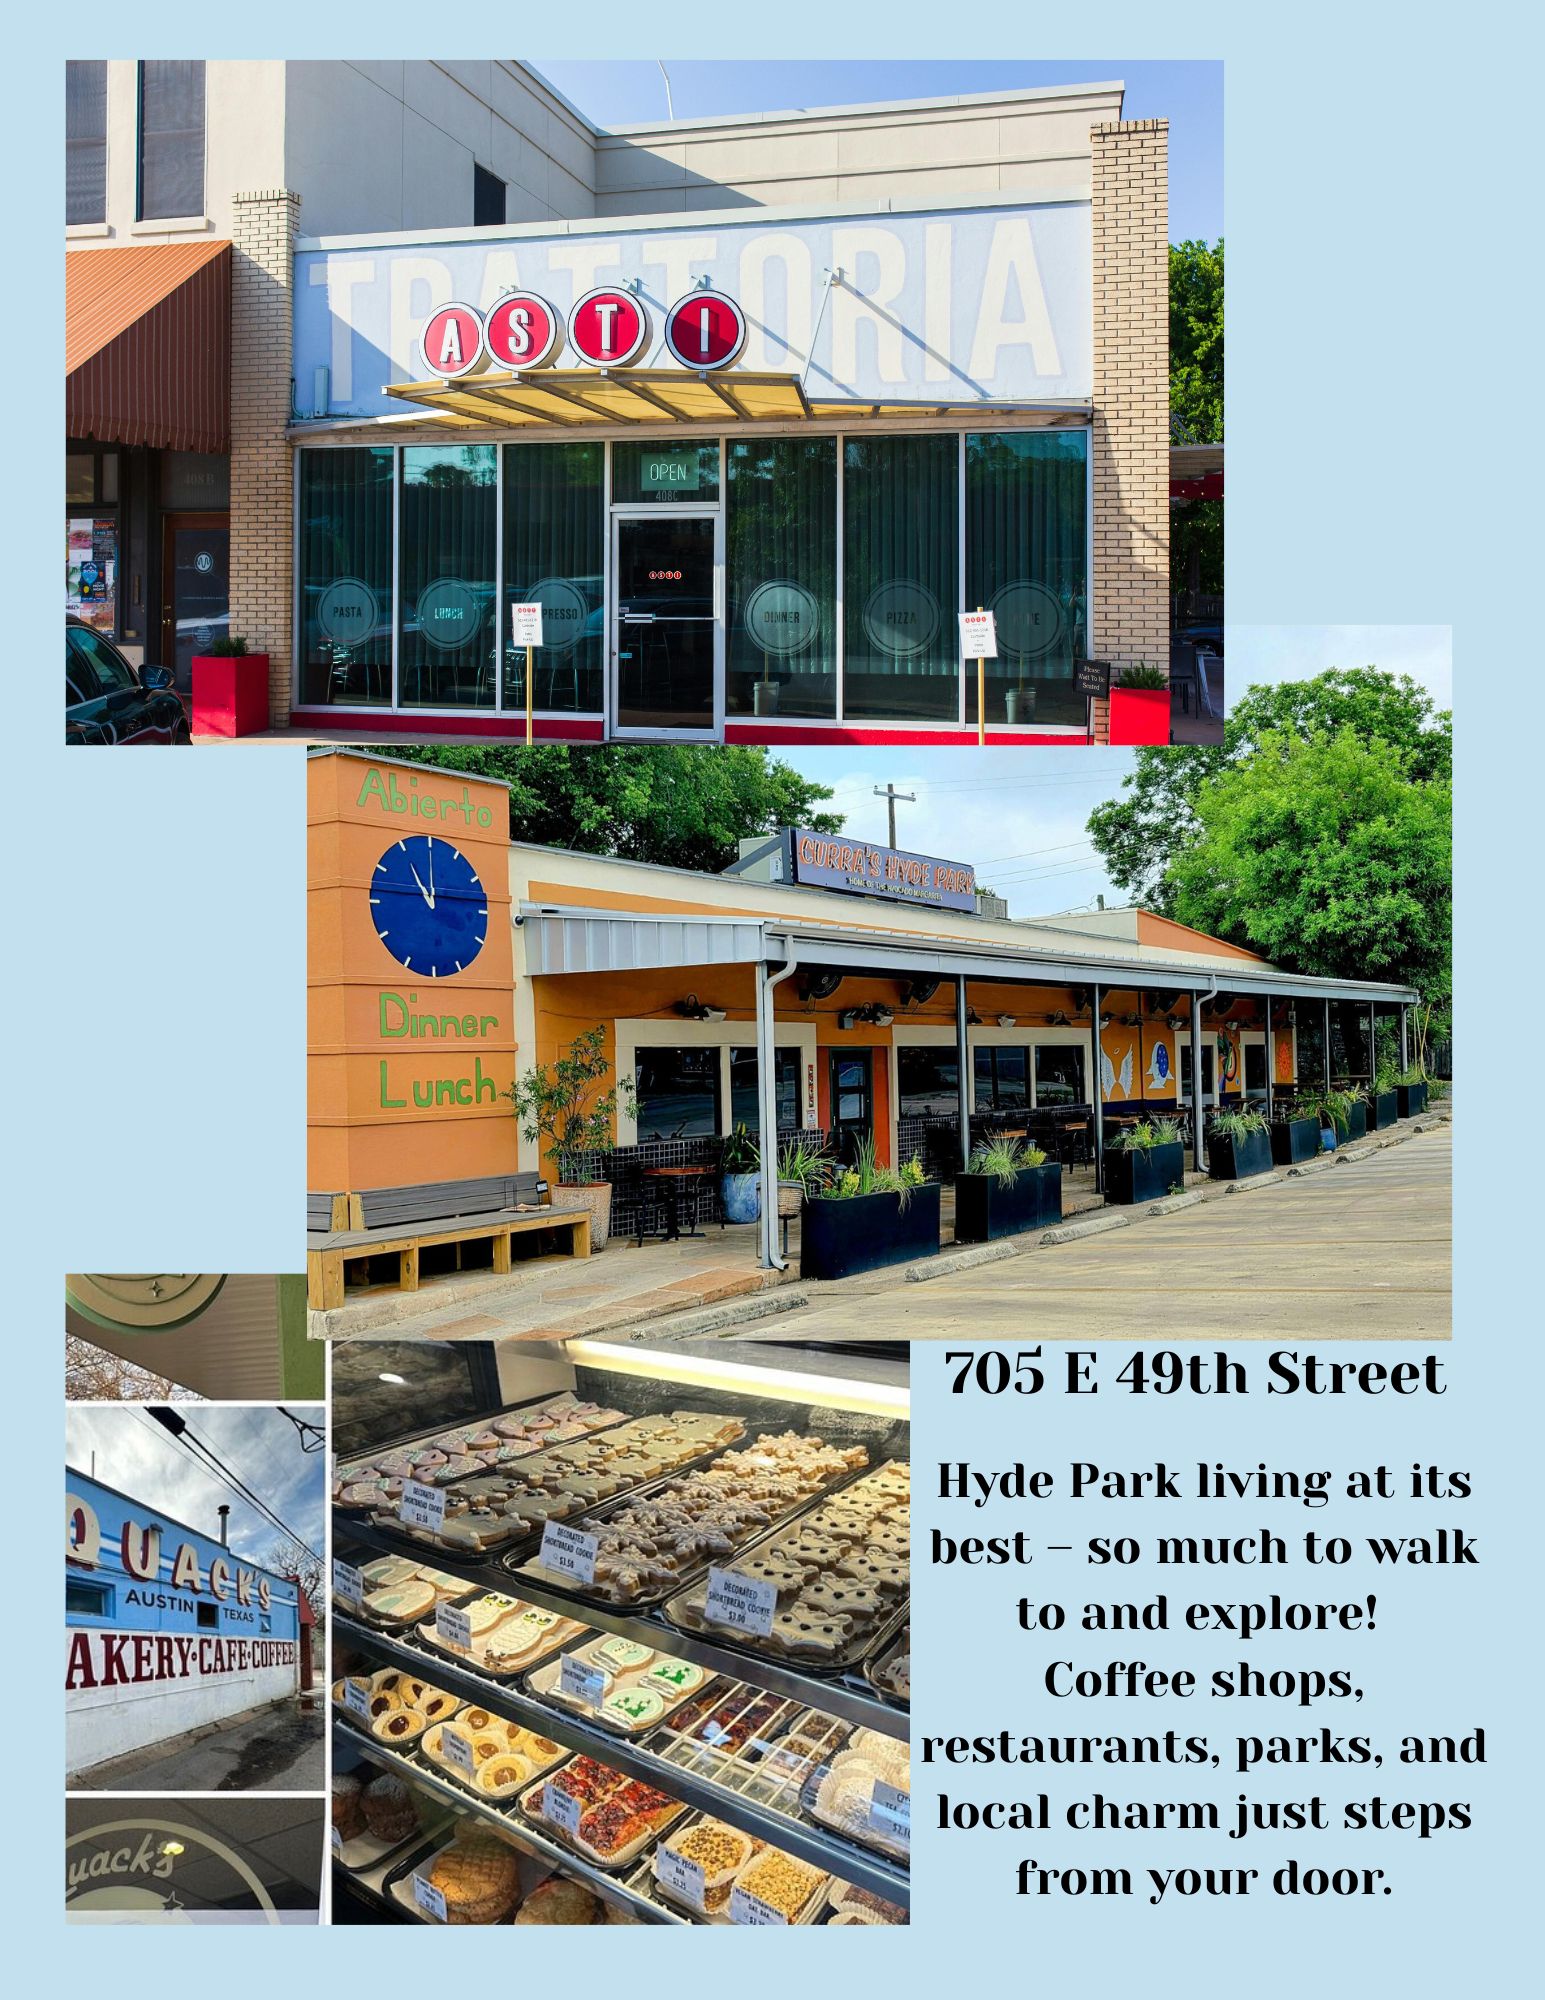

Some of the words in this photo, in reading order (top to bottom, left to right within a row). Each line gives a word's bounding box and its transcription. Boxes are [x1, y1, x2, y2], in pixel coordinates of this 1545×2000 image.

[437, 300, 712, 366] ASTI
[650, 463, 687, 481] OPEN
[655, 490, 678, 501] 408C
[333, 606, 362, 618] PASTA
[434, 607, 463, 619] LUNCH
[542, 608, 578, 619] PRESSO
[764, 611, 800, 624] DINNER
[886, 611, 917, 624] PIZZA
[1084, 665, 1101, 674] Please
[1091, 674, 1099, 682] To
[357, 767, 493, 828] Abierto
[800, 836, 882, 877] CURRA'S
[885, 854, 931, 888] HYDE
[934, 865, 976, 896] PARK
[378, 992, 499, 1038] Dinner
[379, 1057, 497, 1108] Lunch
[557, 1527, 585, 1544] DECORATED
[66, 1493, 272, 1612] QUACK'S
[708, 1590, 746, 1610] SHORTBREAD
[724, 1581, 758, 1600] DECORATED
[125, 1588, 194, 1613] AUSTIN
[222, 1607, 255, 1622] TEXAS
[200, 1637, 248, 1675] CAFE
[251, 1640, 294, 1669] COFFEE
[66, 1832, 176, 1890] uack's
